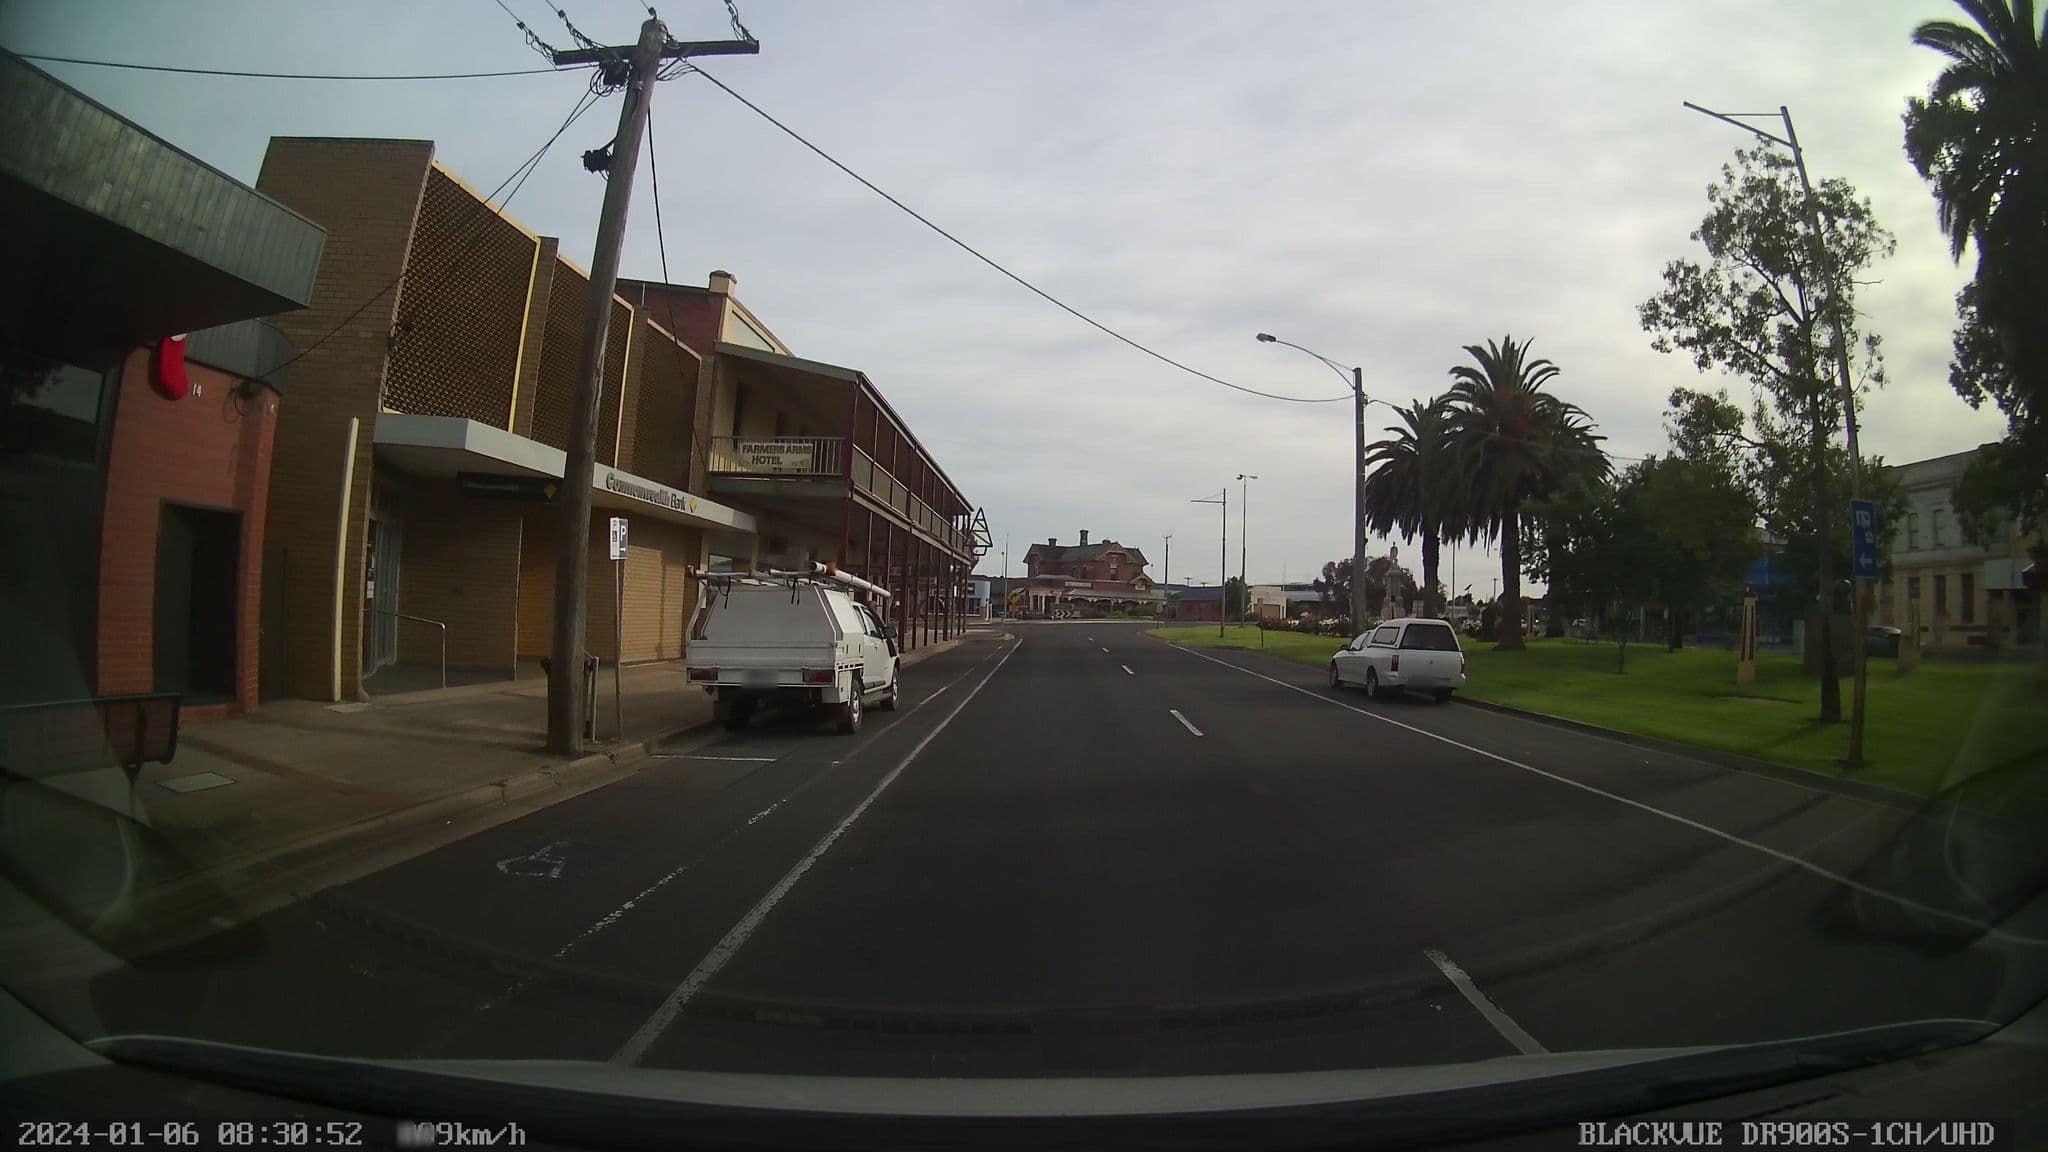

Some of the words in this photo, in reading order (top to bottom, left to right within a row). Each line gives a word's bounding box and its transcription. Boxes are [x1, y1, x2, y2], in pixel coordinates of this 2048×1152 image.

[743, 445, 784, 454] FARMERS
[785, 445, 812, 455] ARMS
[752, 455, 783, 465] HOTEL
[670, 493, 686, 511] Bank
[620, 525, 627, 541] P
